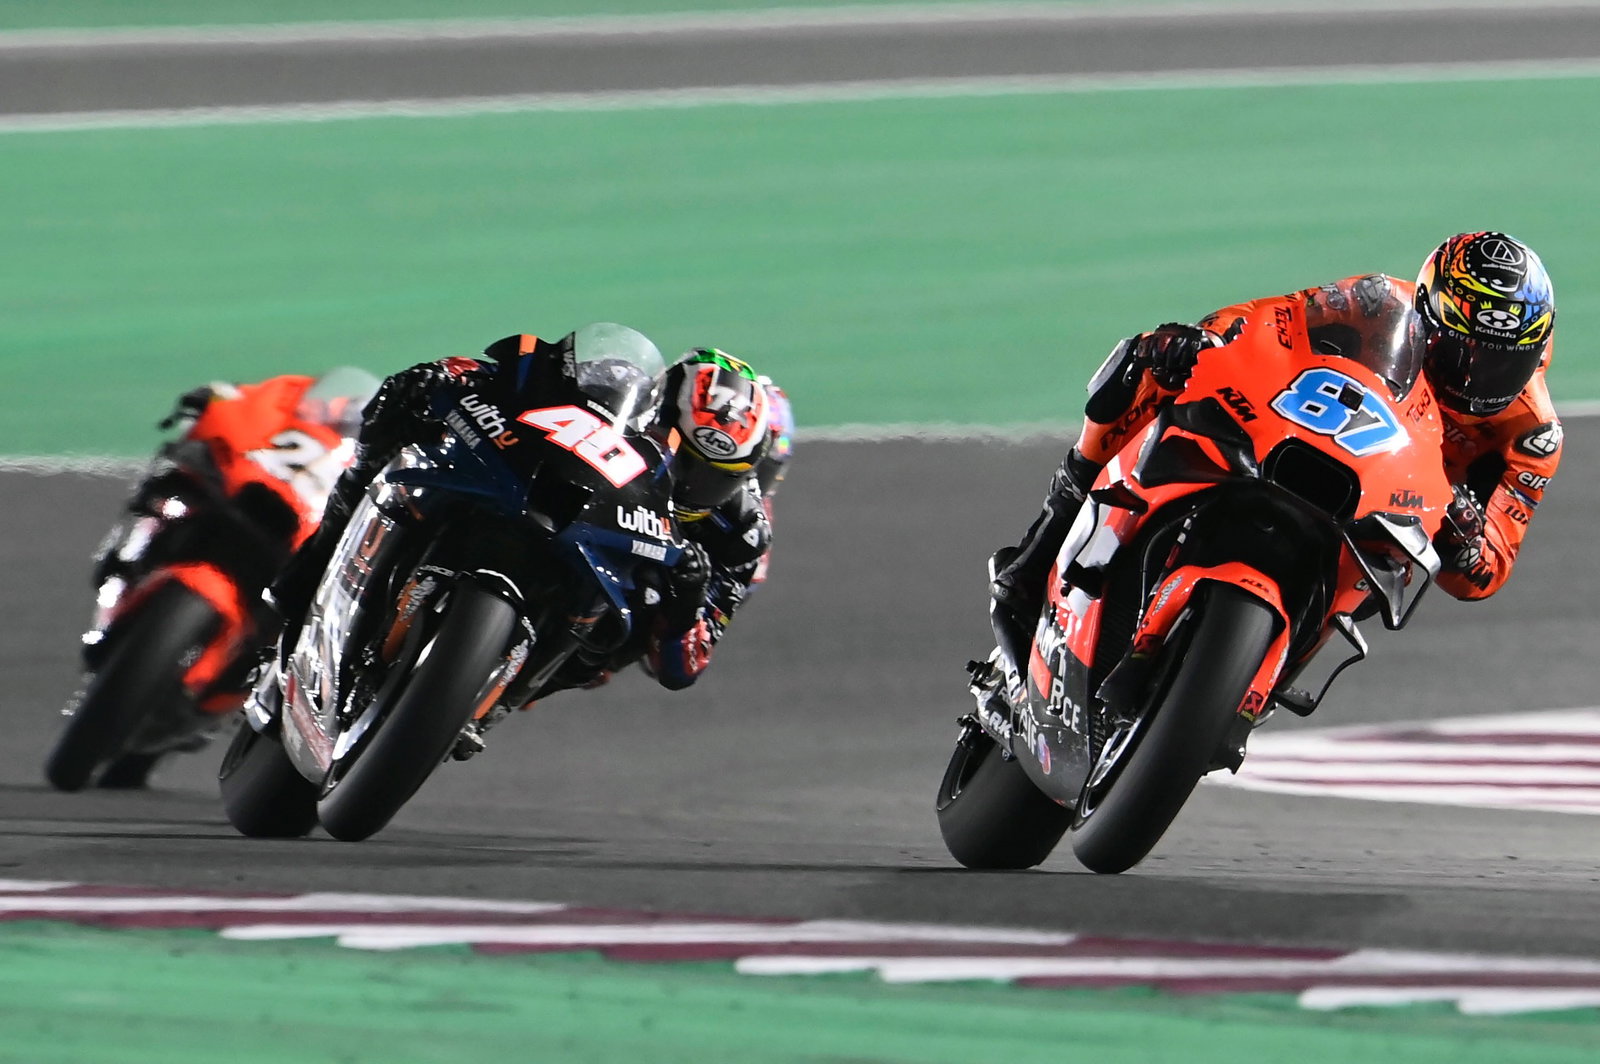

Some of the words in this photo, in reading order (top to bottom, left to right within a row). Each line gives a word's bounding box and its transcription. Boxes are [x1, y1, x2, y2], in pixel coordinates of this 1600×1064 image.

[1274, 306, 1293, 350] TECH3
[1215, 386, 1259, 423] KTM
[1270, 367, 1410, 458] 87
[444, 409, 482, 450] YAMAHA
[1388, 489, 1424, 509] KTM
